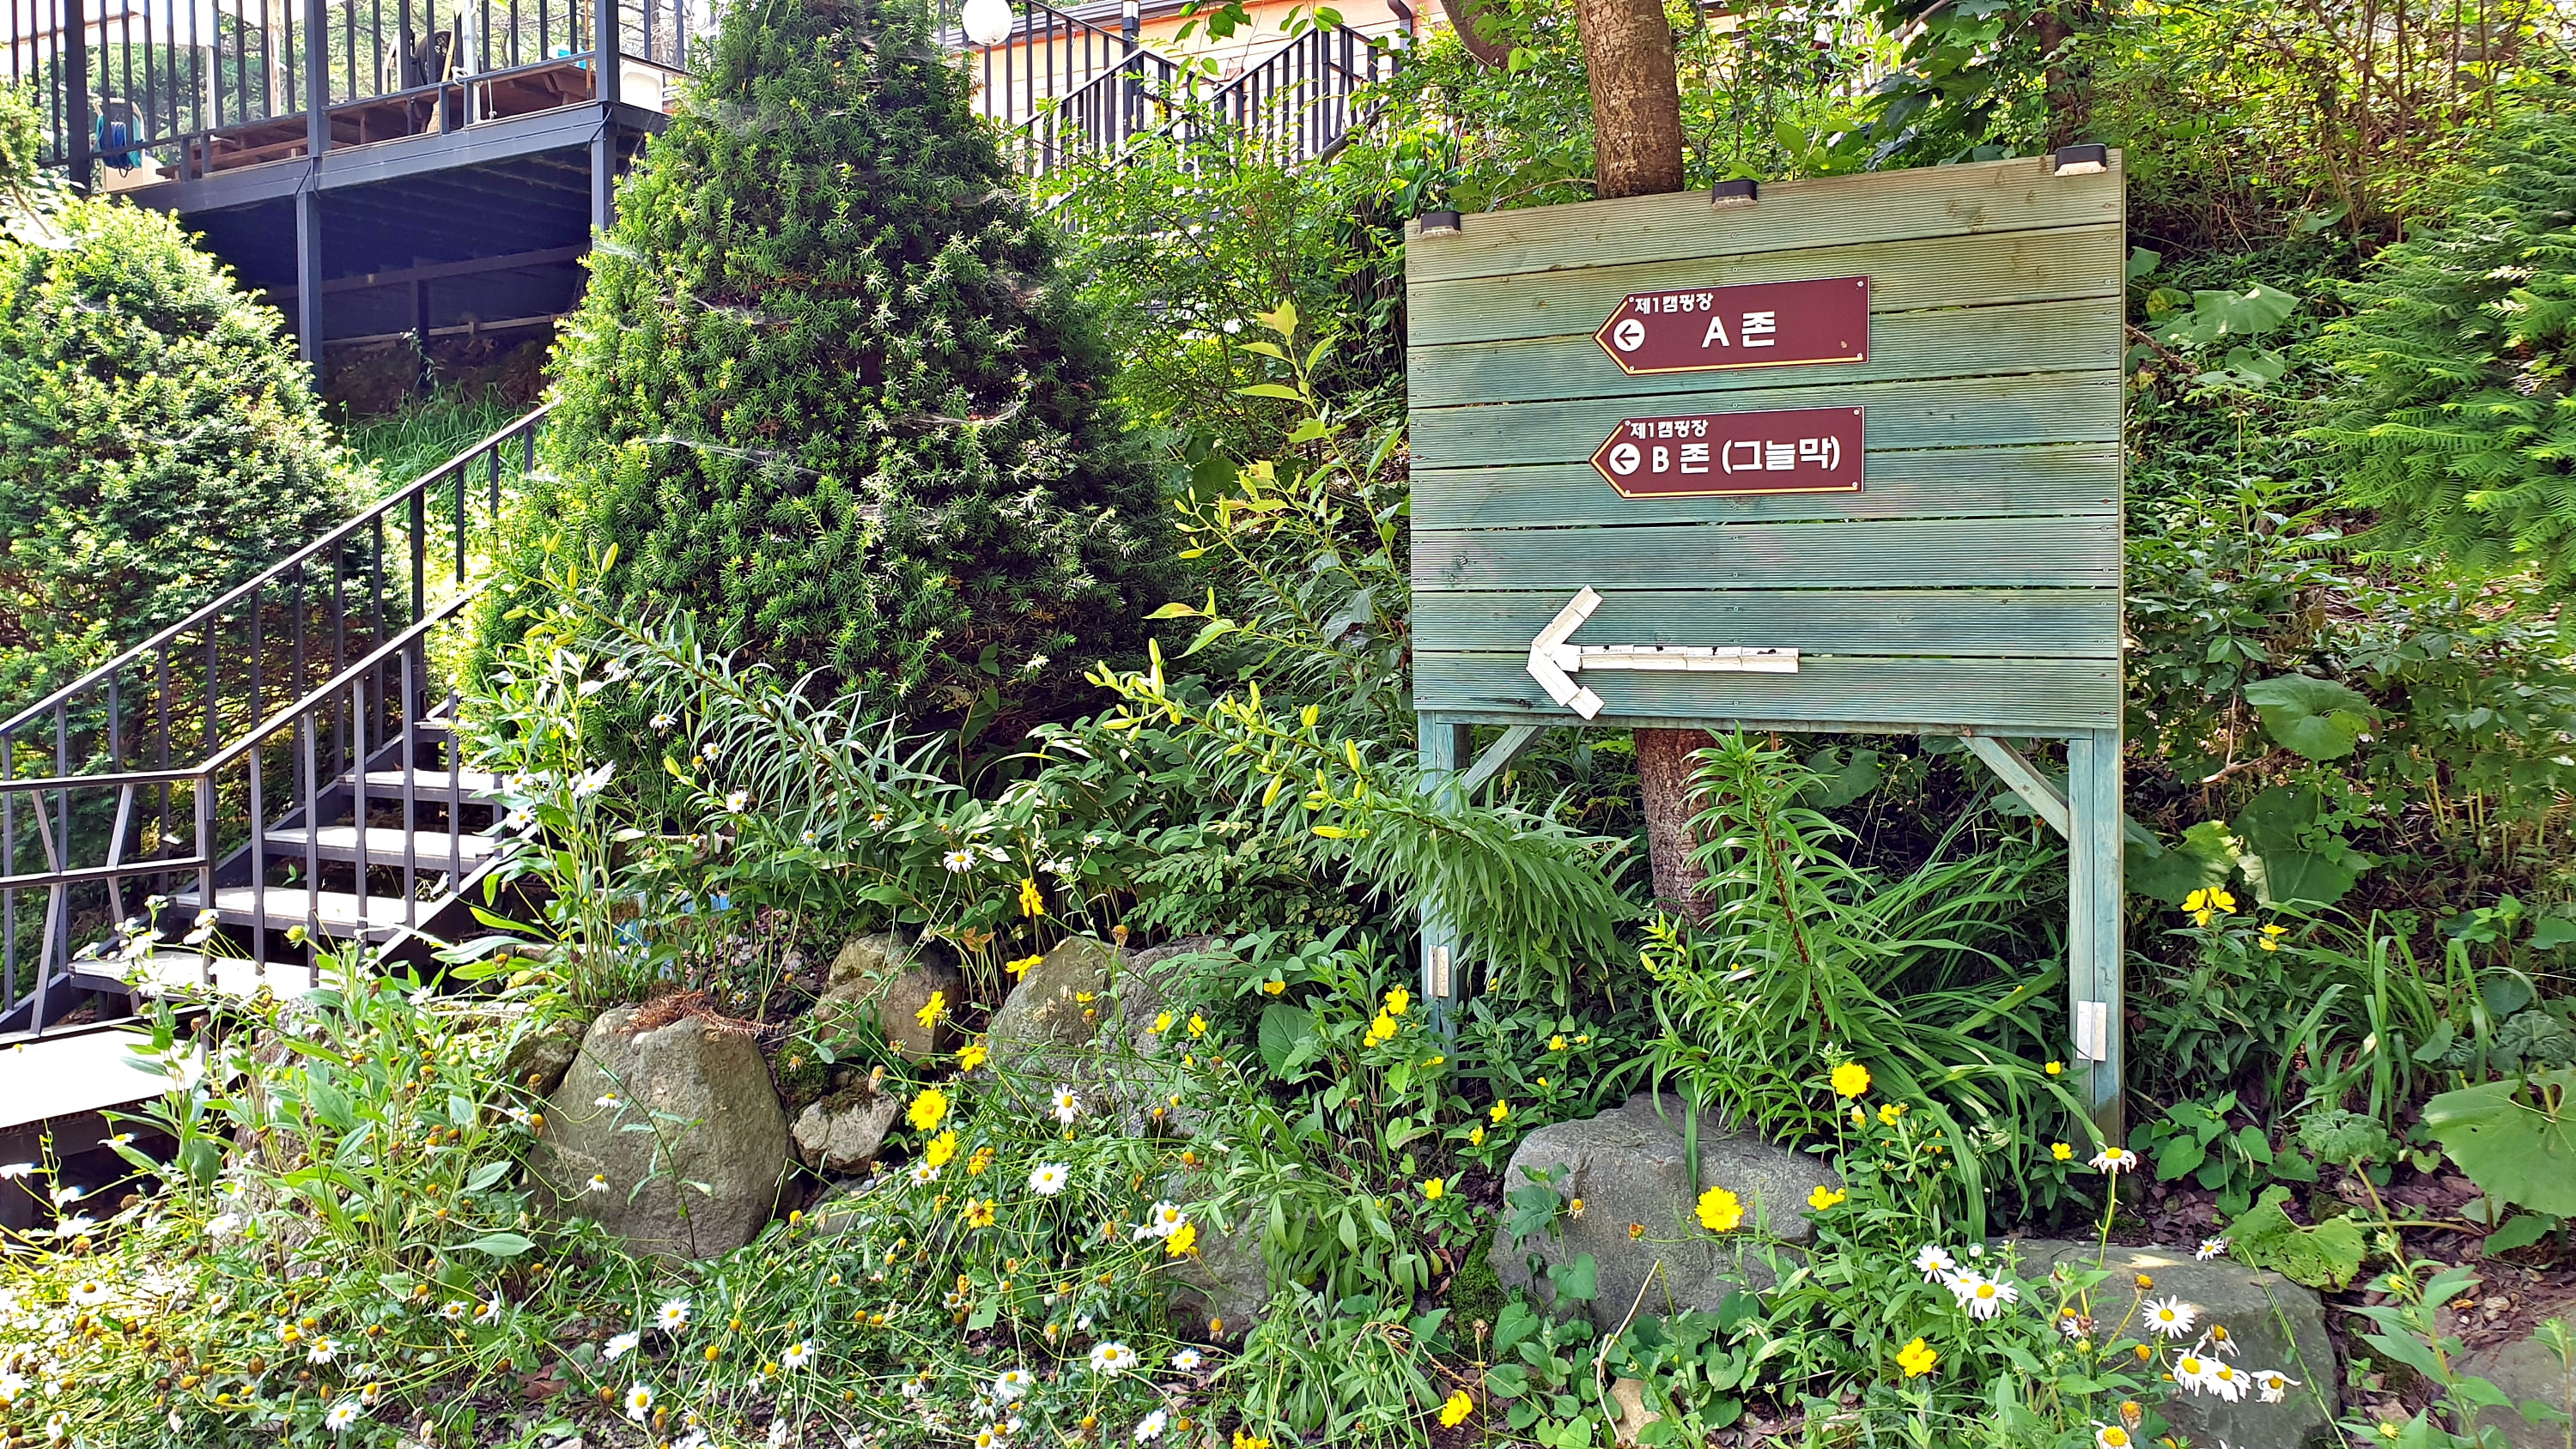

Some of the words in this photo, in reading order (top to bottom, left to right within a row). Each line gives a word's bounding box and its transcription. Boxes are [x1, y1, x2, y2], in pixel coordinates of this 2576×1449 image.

[1634, 293, 1714, 314] 제1캠핑장
[1701, 316, 1730, 349] A
[1741, 311, 1777, 348] 존
[1630, 420, 1709, 440] 제1캠핑장
[1651, 446, 1670, 474] B
[1680, 442, 1710, 474] 존
[1721, 435, 1841, 475] (그늘막)
